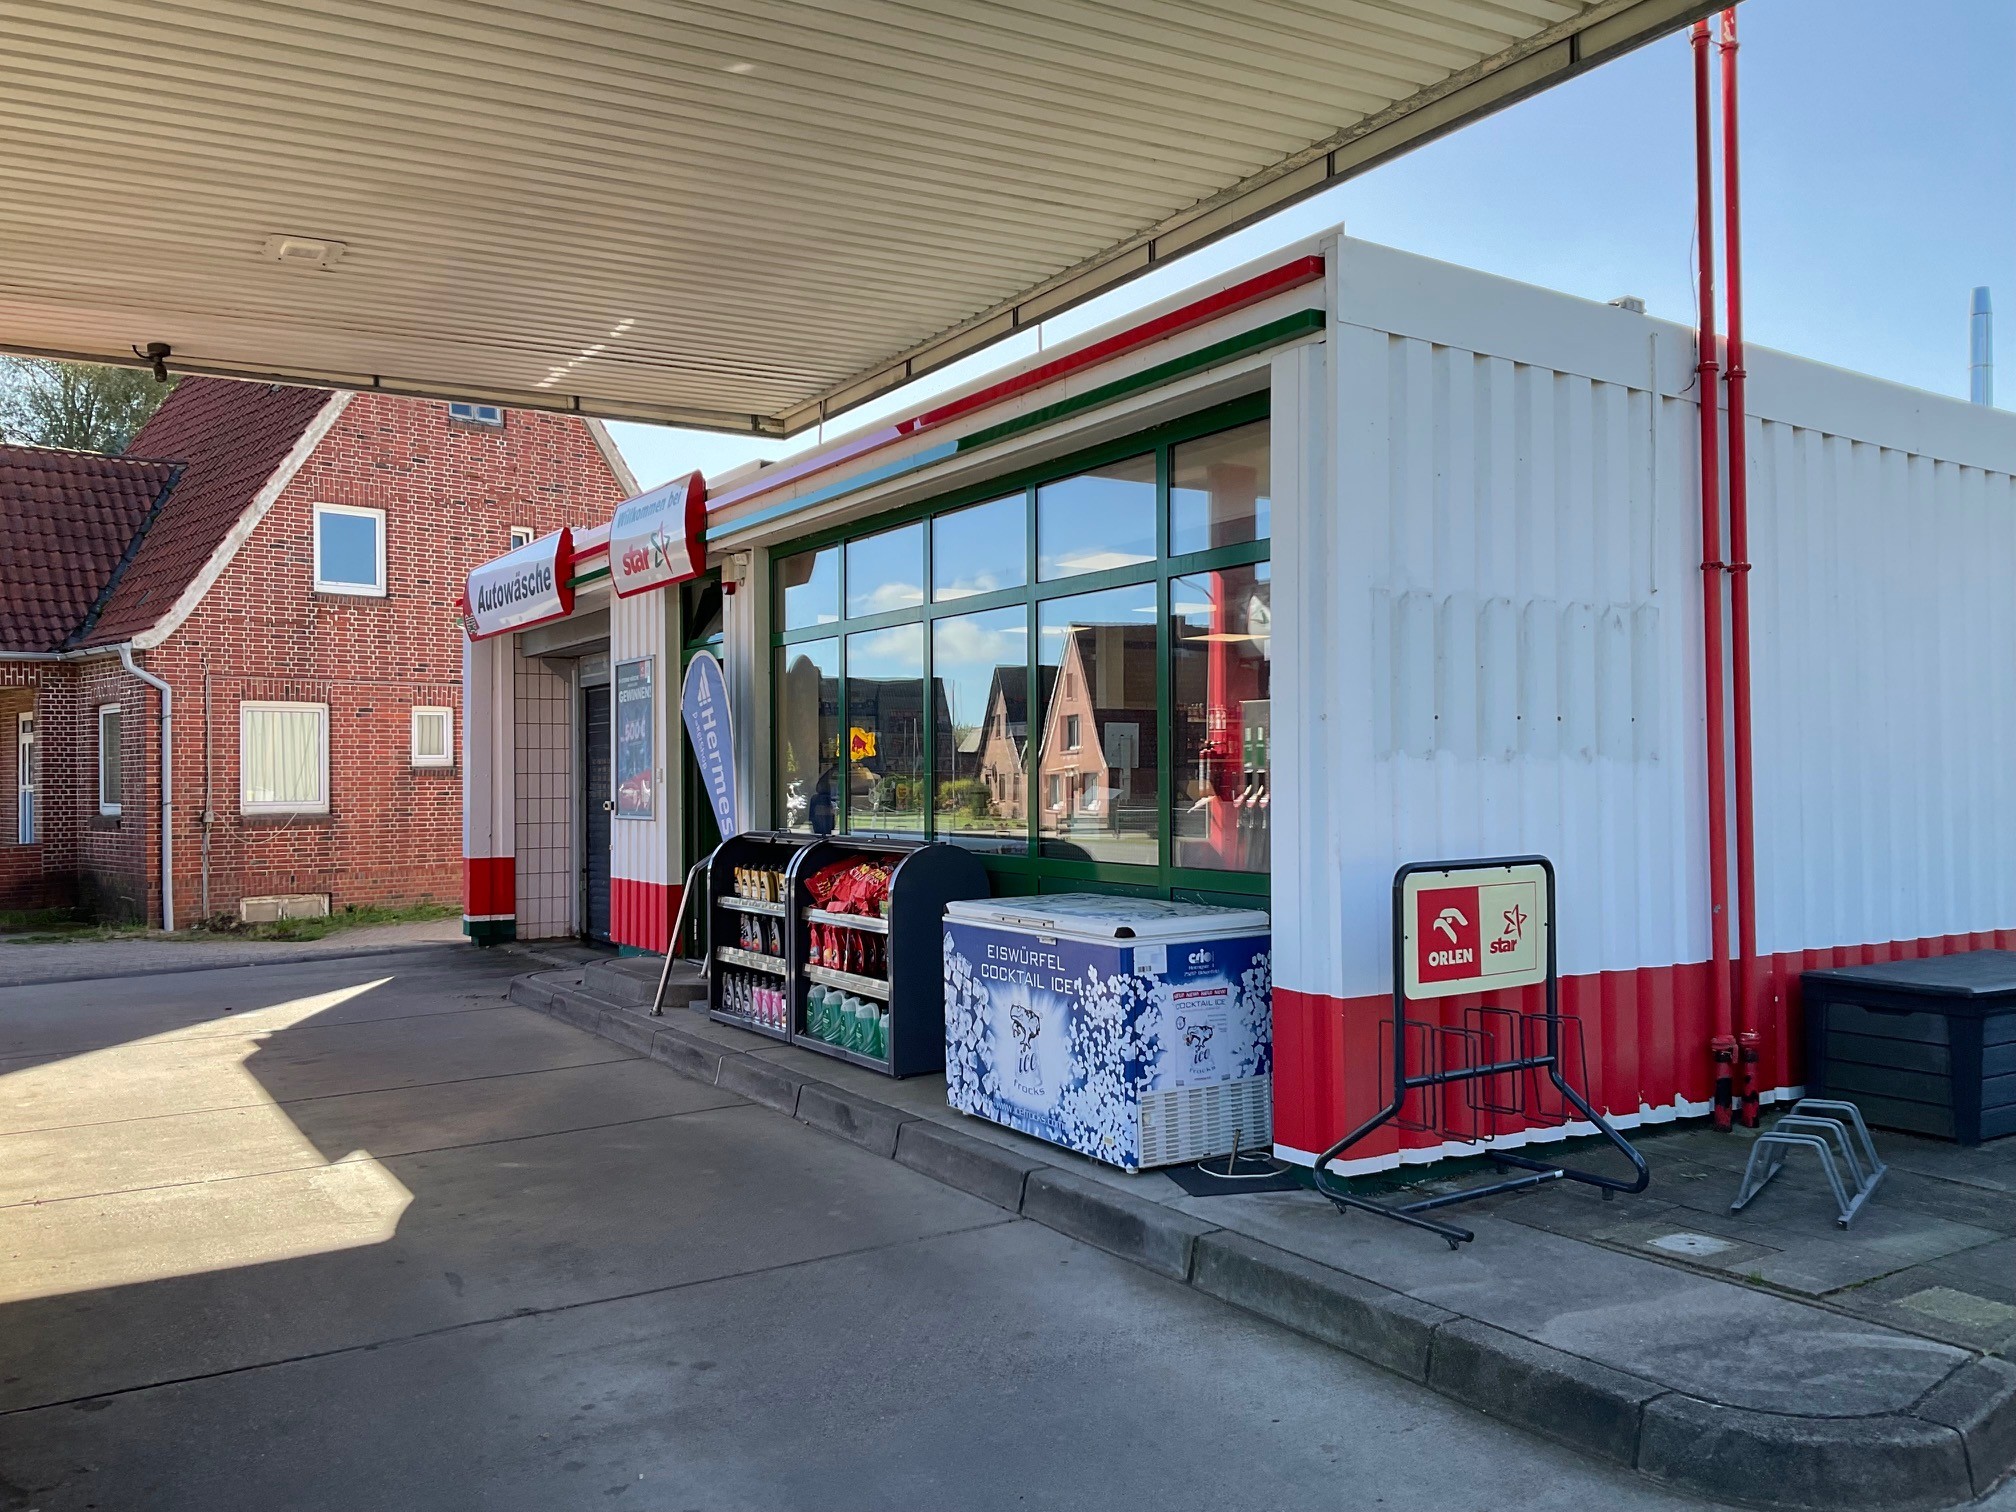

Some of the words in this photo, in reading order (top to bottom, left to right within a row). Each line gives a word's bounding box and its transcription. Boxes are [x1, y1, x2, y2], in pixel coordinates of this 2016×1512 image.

[617, 499, 666, 529] Willkommen
[667, 486, 683, 511] bei
[622, 543, 650, 577] star
[478, 563, 552, 614] Autowäsche
[701, 706, 735, 836] Hermes
[987, 943, 1066, 971] EISWÜRFEL
[1428, 948, 1473, 967] ORLEN
[1489, 937, 1517, 954] star
[981, 962, 1045, 989] COCKTAIL
[1051, 976, 1074, 995] ICE
[1175, 1000, 1213, 1011] COCKTAIL
[1214, 998, 1226, 1006] ICE
